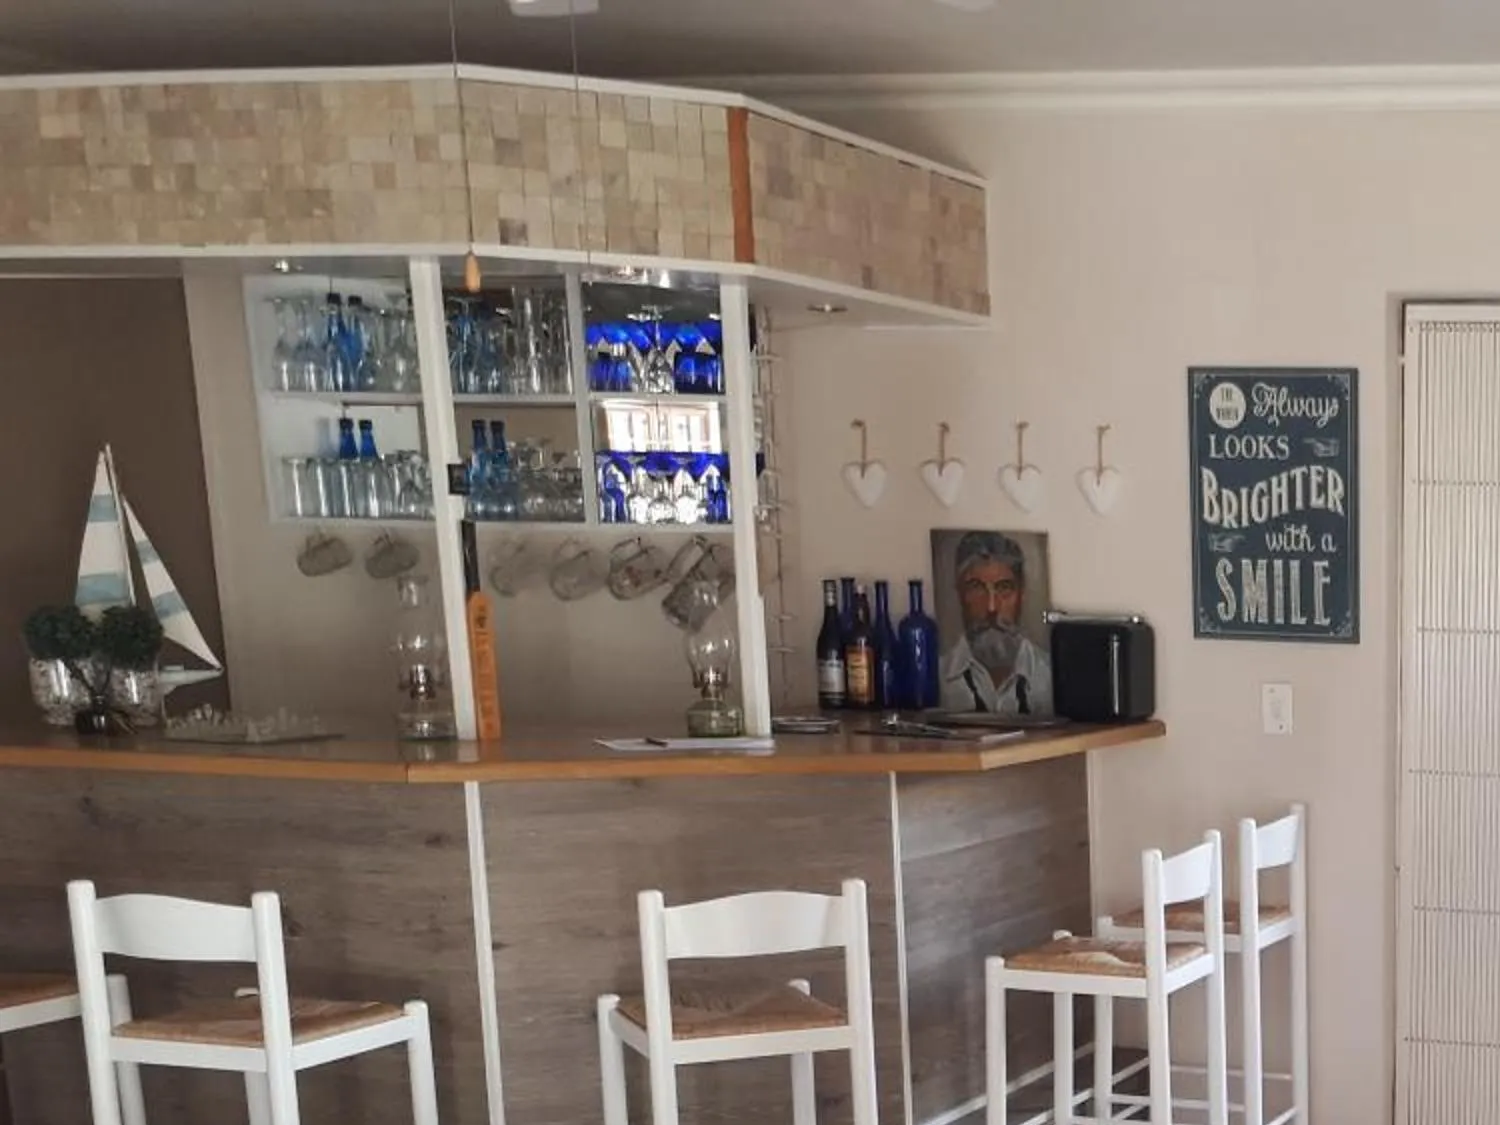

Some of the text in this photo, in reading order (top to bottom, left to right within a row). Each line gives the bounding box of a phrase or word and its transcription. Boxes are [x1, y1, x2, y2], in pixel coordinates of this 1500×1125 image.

[1251, 382, 1339, 428] Always
[1209, 435, 1290, 459] LOOKS
[1200, 466, 1344, 528] BRIGHTER
[1265, 524, 1337, 553] with a
[1215, 558, 1331, 625] SMILE
